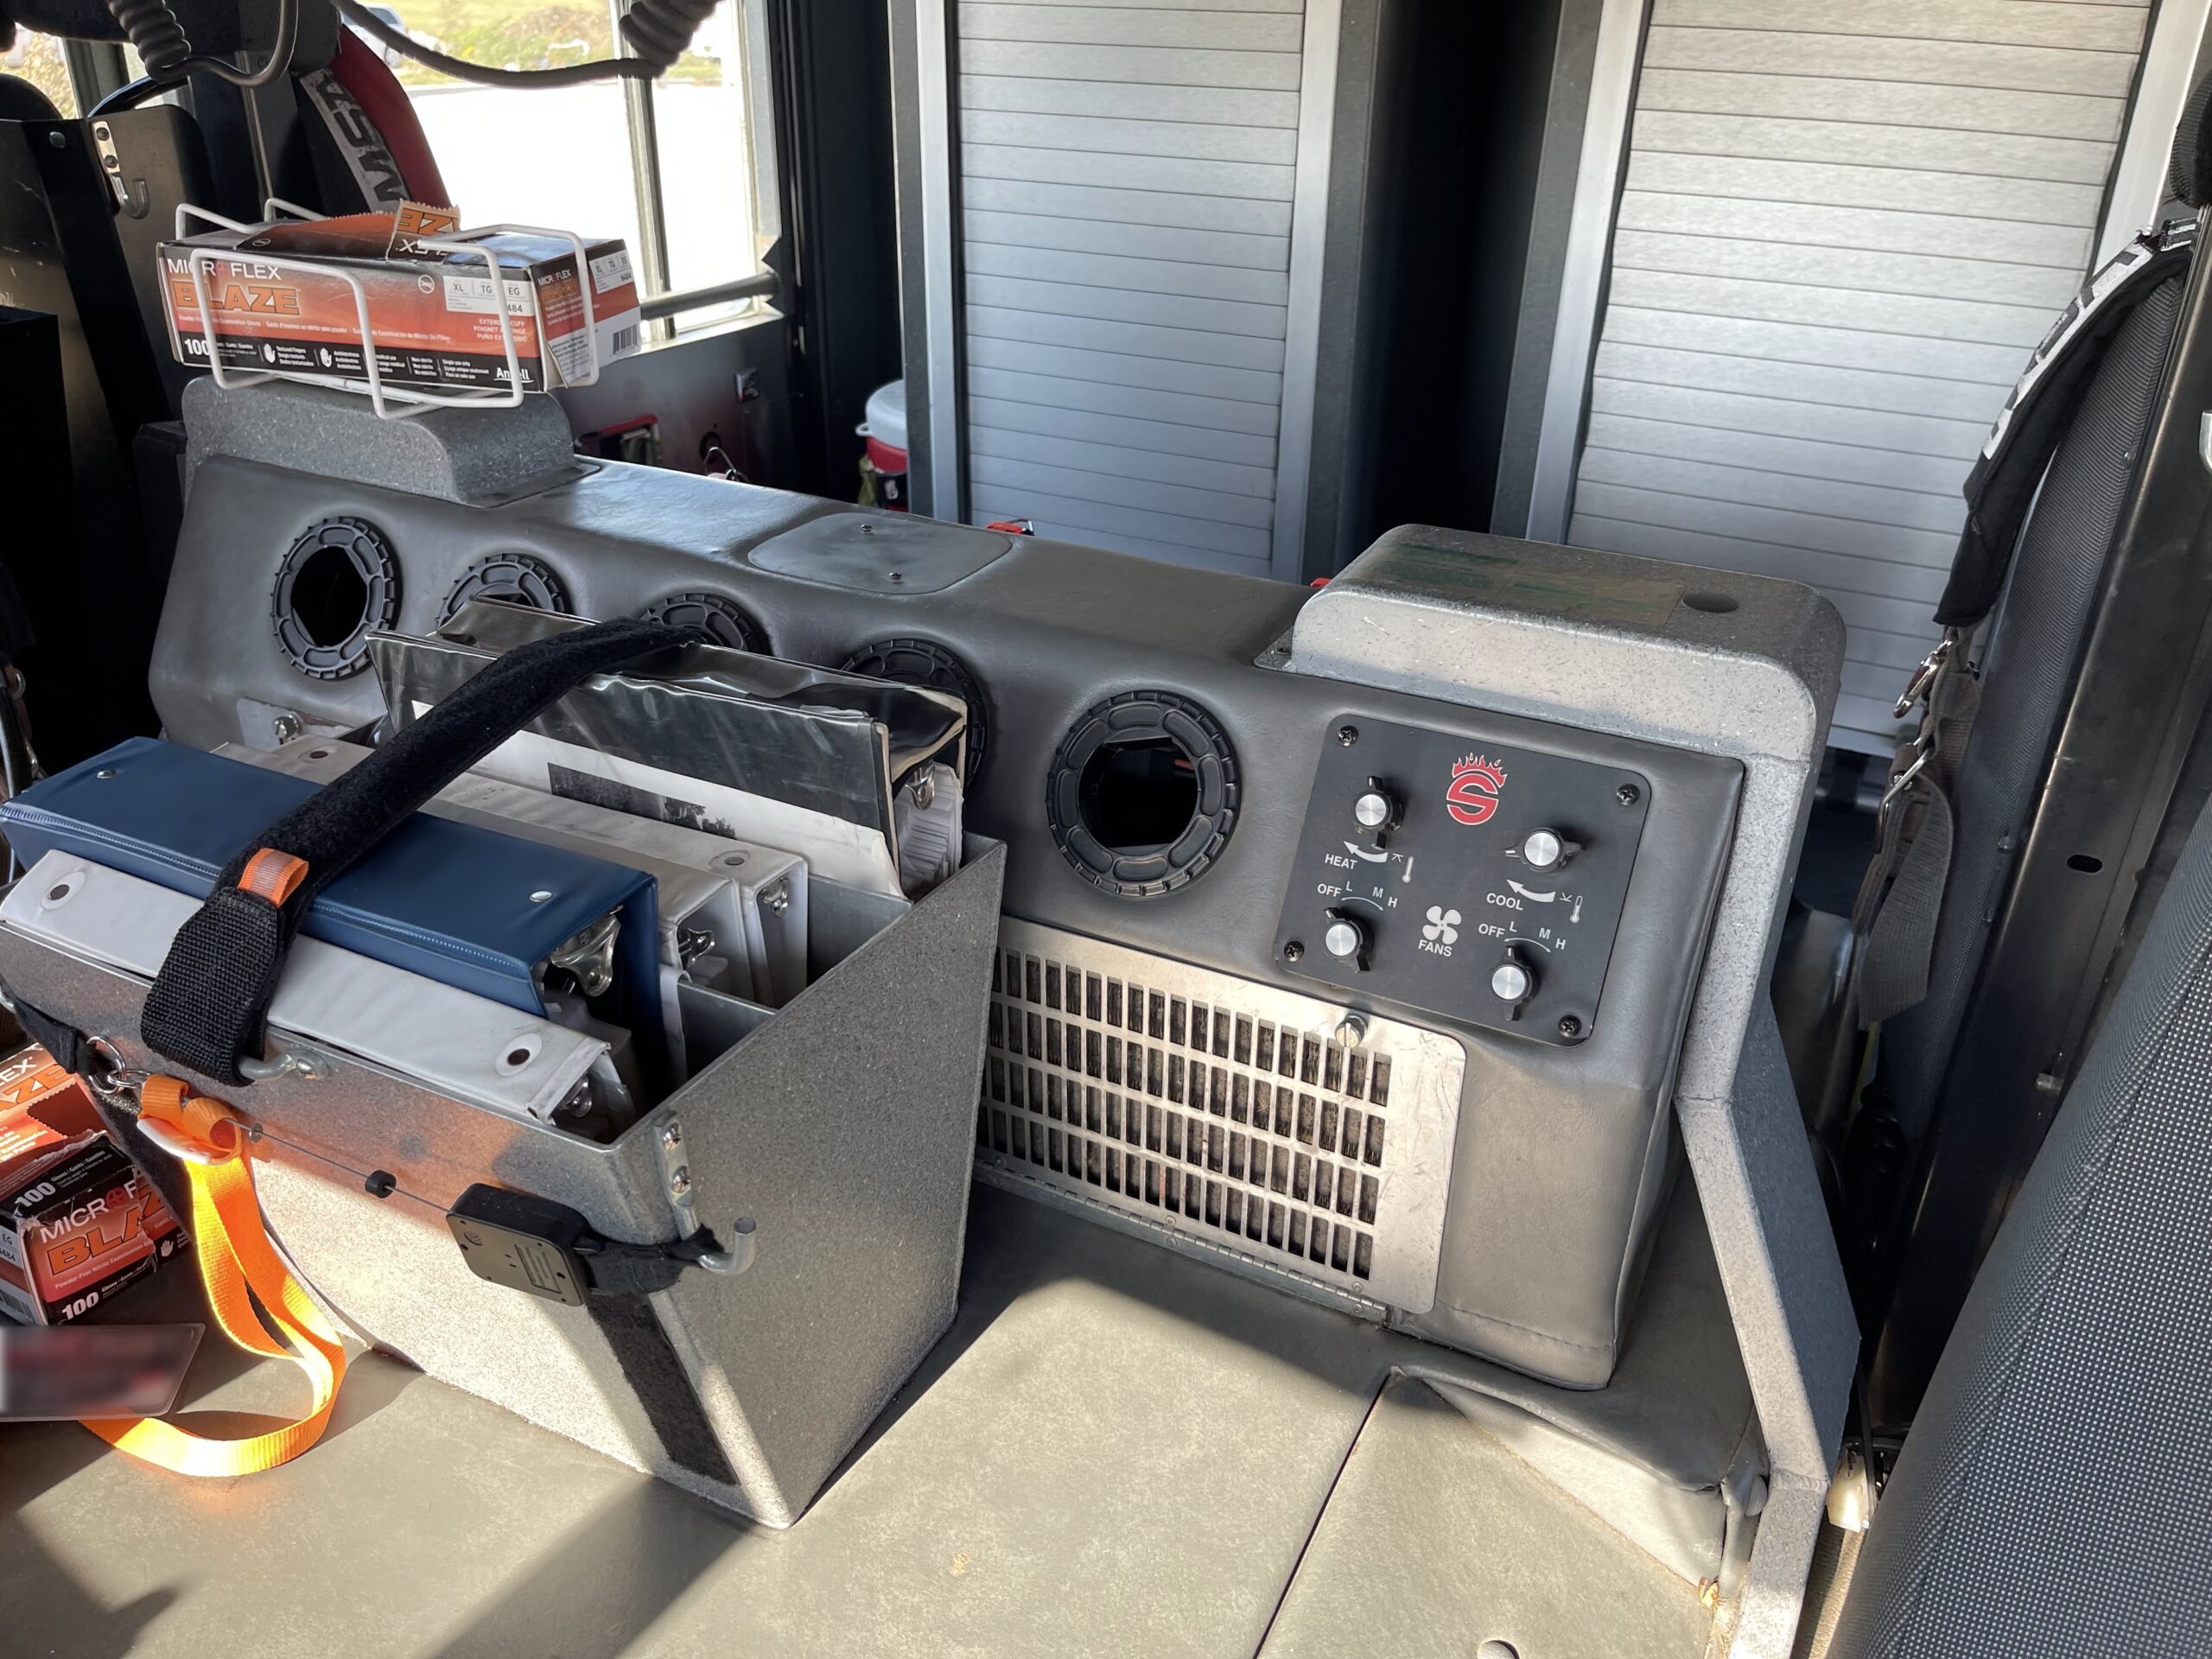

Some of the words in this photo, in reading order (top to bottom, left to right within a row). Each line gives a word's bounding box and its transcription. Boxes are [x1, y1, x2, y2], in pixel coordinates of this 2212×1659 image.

[454, 283, 465, 292] XL
[481, 285, 493, 294] TG
[496, 366, 530, 380] Anll
[1325, 853, 1357, 870] HEAT
[1317, 883, 1342, 898] OFF
[1345, 881, 1353, 892] L
[1372, 887, 1384, 899] M
[1387, 897, 1398, 908] H
[1486, 893, 1523, 911] COOL
[1478, 924, 1505, 939] OFF
[1509, 921, 1517, 932] L
[1538, 927, 1551, 939] M
[1418, 939, 1452, 957] FANS
[1555, 938, 1567, 950] H
[15, 1182, 56, 1207] 100
[2, 1233, 13, 1245] EG
[54, 1268, 92, 1290] Powder-Free
[92, 1260, 110, 1273] Nitrile
[110, 1244, 143, 1264] Examination
[101, 1280, 118, 1294] Gloves
[61, 1291, 99, 1321] 100
